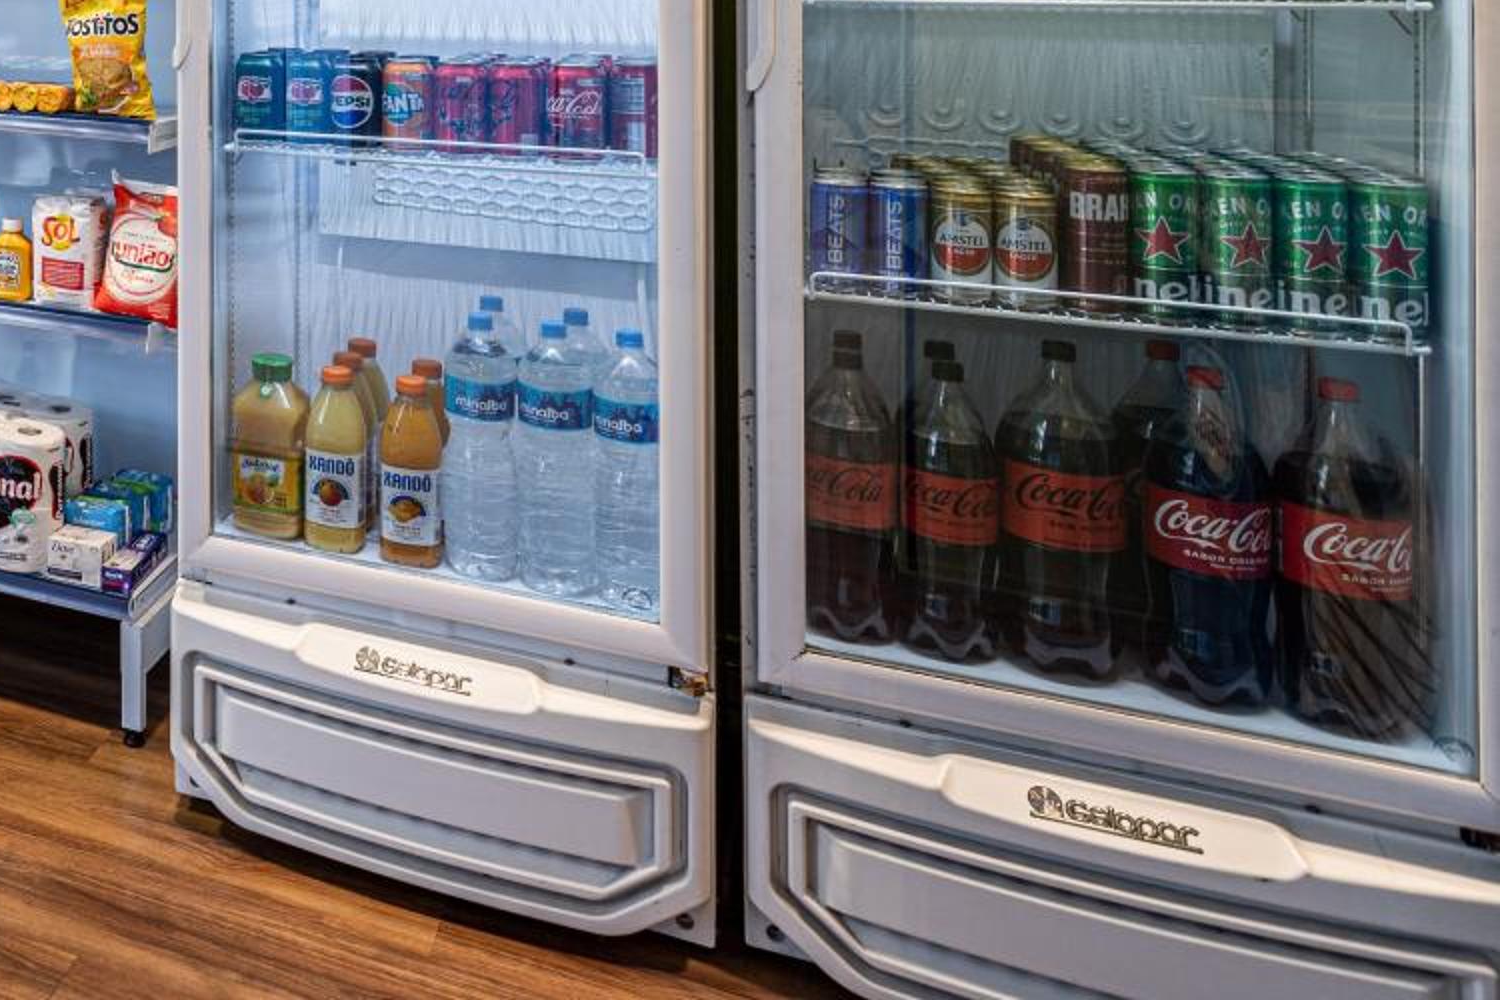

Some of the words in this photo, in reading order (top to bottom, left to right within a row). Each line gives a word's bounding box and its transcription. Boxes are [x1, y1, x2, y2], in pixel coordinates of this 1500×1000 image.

[1069, 191, 1129, 221] BRAH
[940, 233, 984, 246] AMSTEL
[1001, 238, 1045, 251] AMSTEL
